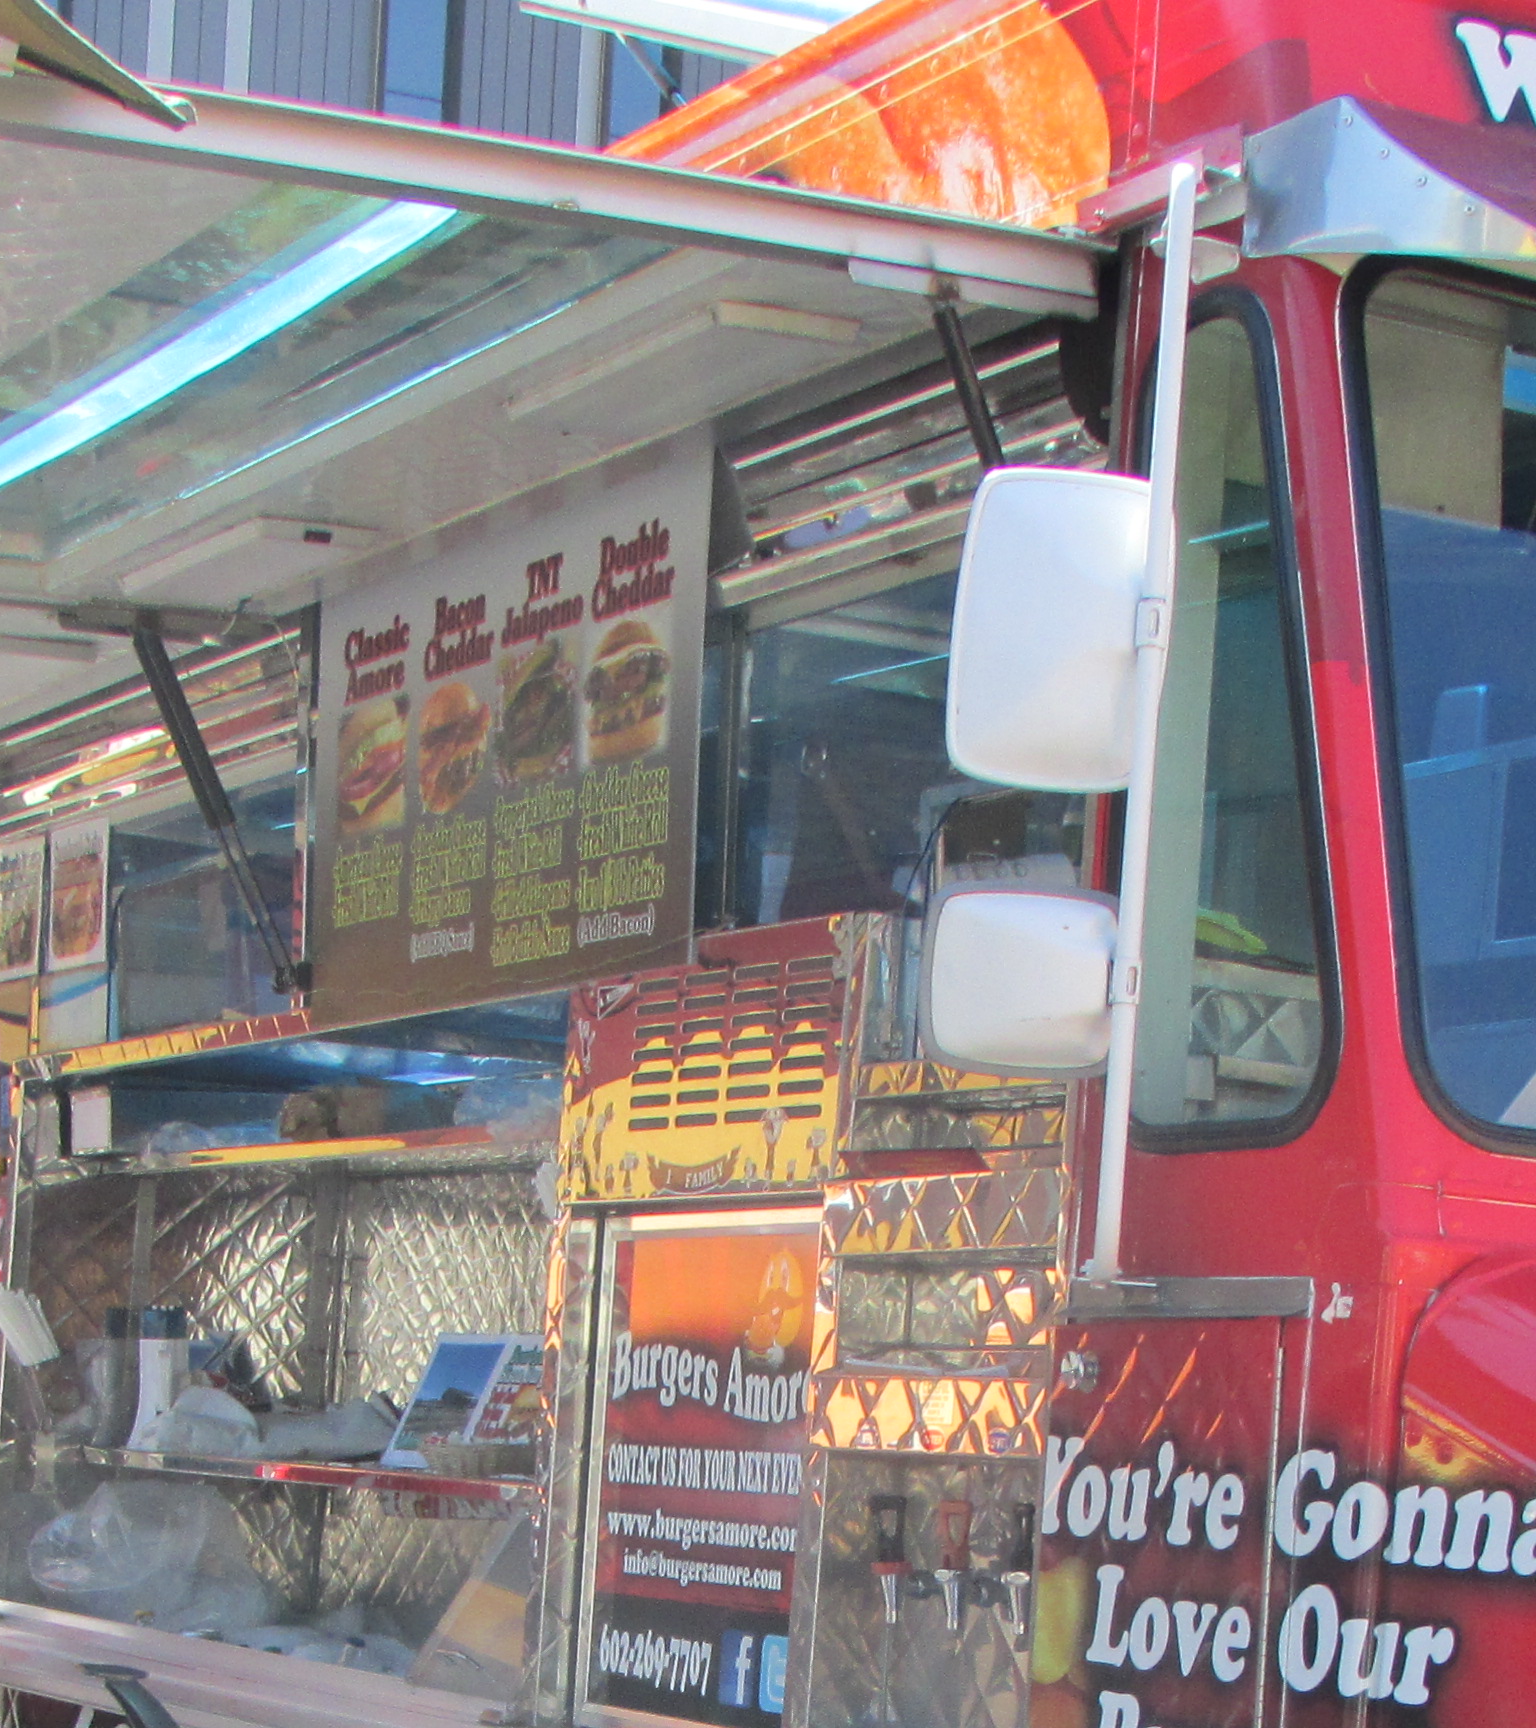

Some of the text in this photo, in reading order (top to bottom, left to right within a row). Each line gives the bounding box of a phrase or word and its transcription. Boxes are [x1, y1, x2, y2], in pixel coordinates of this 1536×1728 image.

[600, 517, 670, 575] Double
[526, 552, 564, 603] TNT
[591, 565, 675, 623] Cheddar
[345, 613, 411, 670] Classic
[435, 594, 486, 638] Bacon
[424, 627, 495, 682] Cheddar
[344, 660, 405, 706] Amore
[685, 1161, 723, 1188] FAMILY
[612, 1330, 719, 1408] Burgers
[608, 1443, 661, 1485] CONTACT
[661, 1447, 677, 1486] US
[678, 1448, 701, 1489] FOR
[703, 1449, 736, 1491] YOUR
[737, 1451, 771, 1493] NEXT
[1041, 1435, 1245, 1550] You're
[623, 1548, 782, 1591] info@burgersamore.com
[599, 1623, 713, 1697] 602-269-7707
[1085, 1563, 1456, 1705] Love Our
